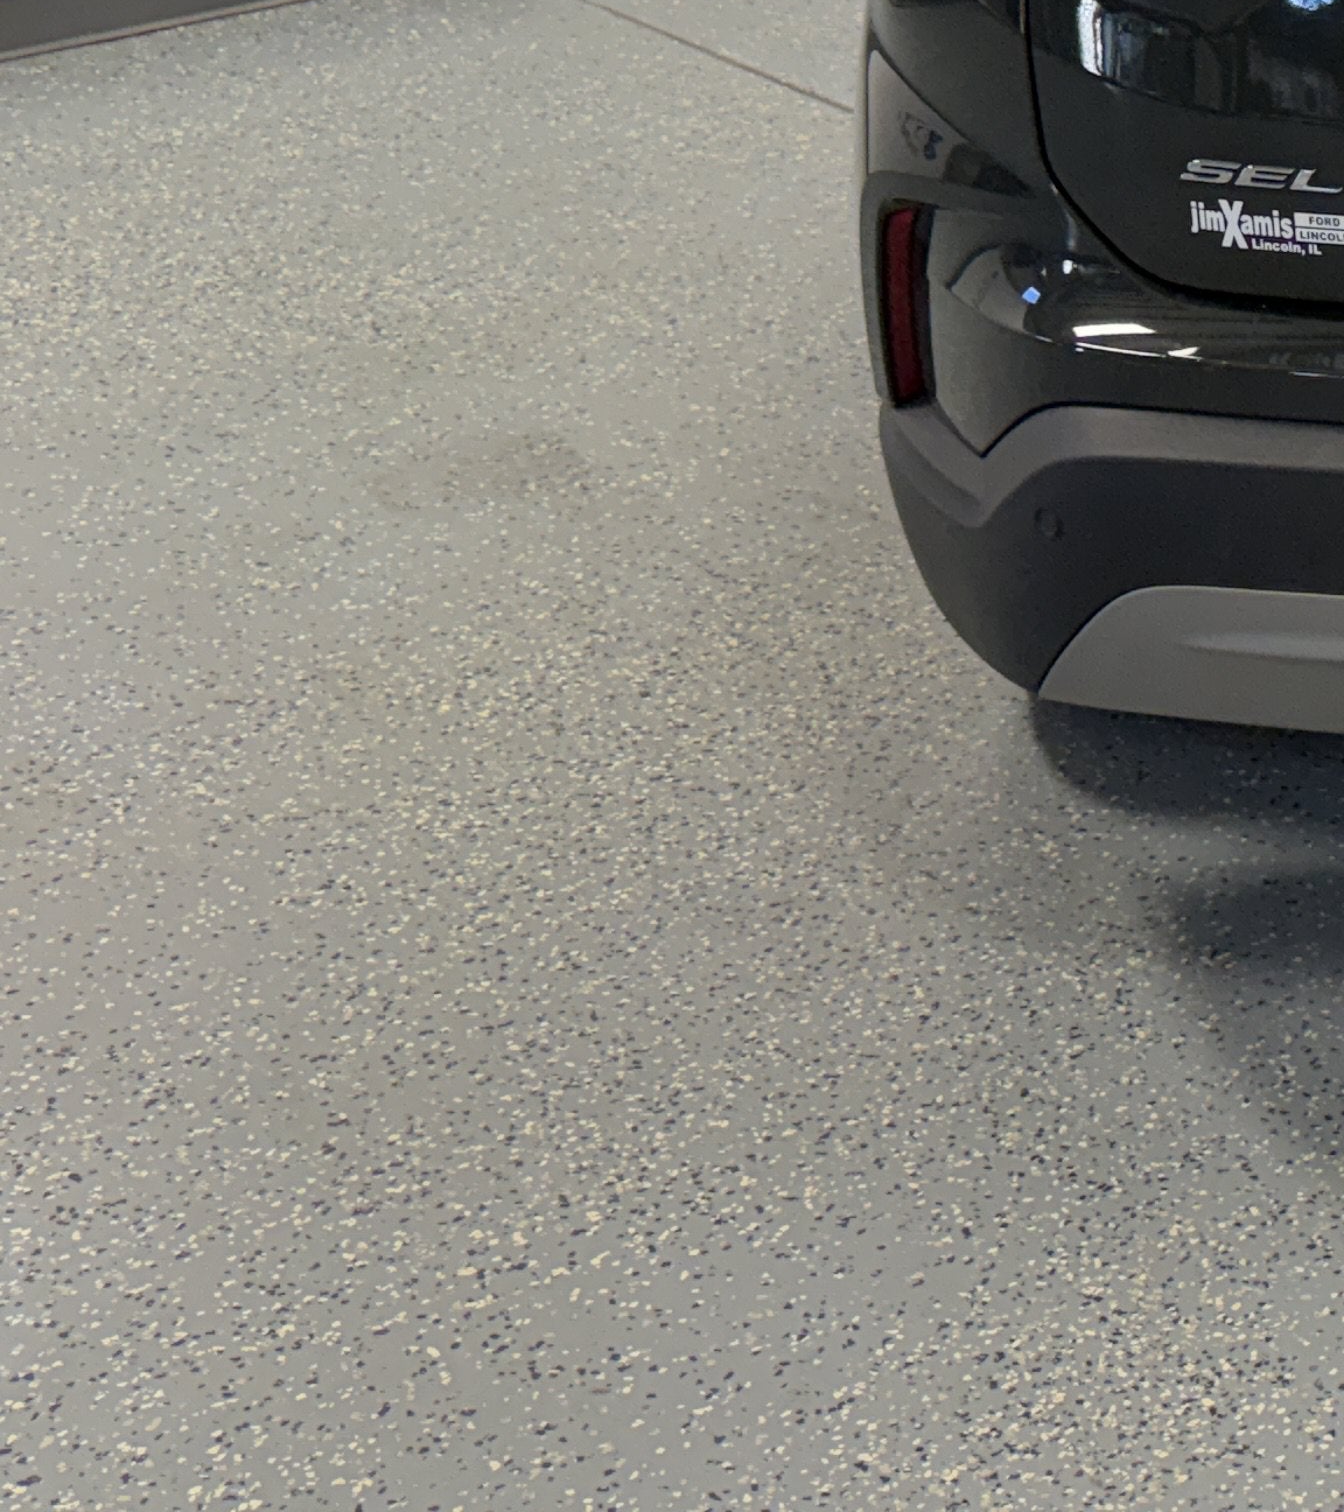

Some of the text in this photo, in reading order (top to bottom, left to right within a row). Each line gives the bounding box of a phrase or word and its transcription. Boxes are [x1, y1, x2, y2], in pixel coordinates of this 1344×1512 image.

[1180, 158, 1344, 194] SEL
[1308, 216, 1340, 226] FORD
[1252, 238, 1322, 256] Lincoln, IL
